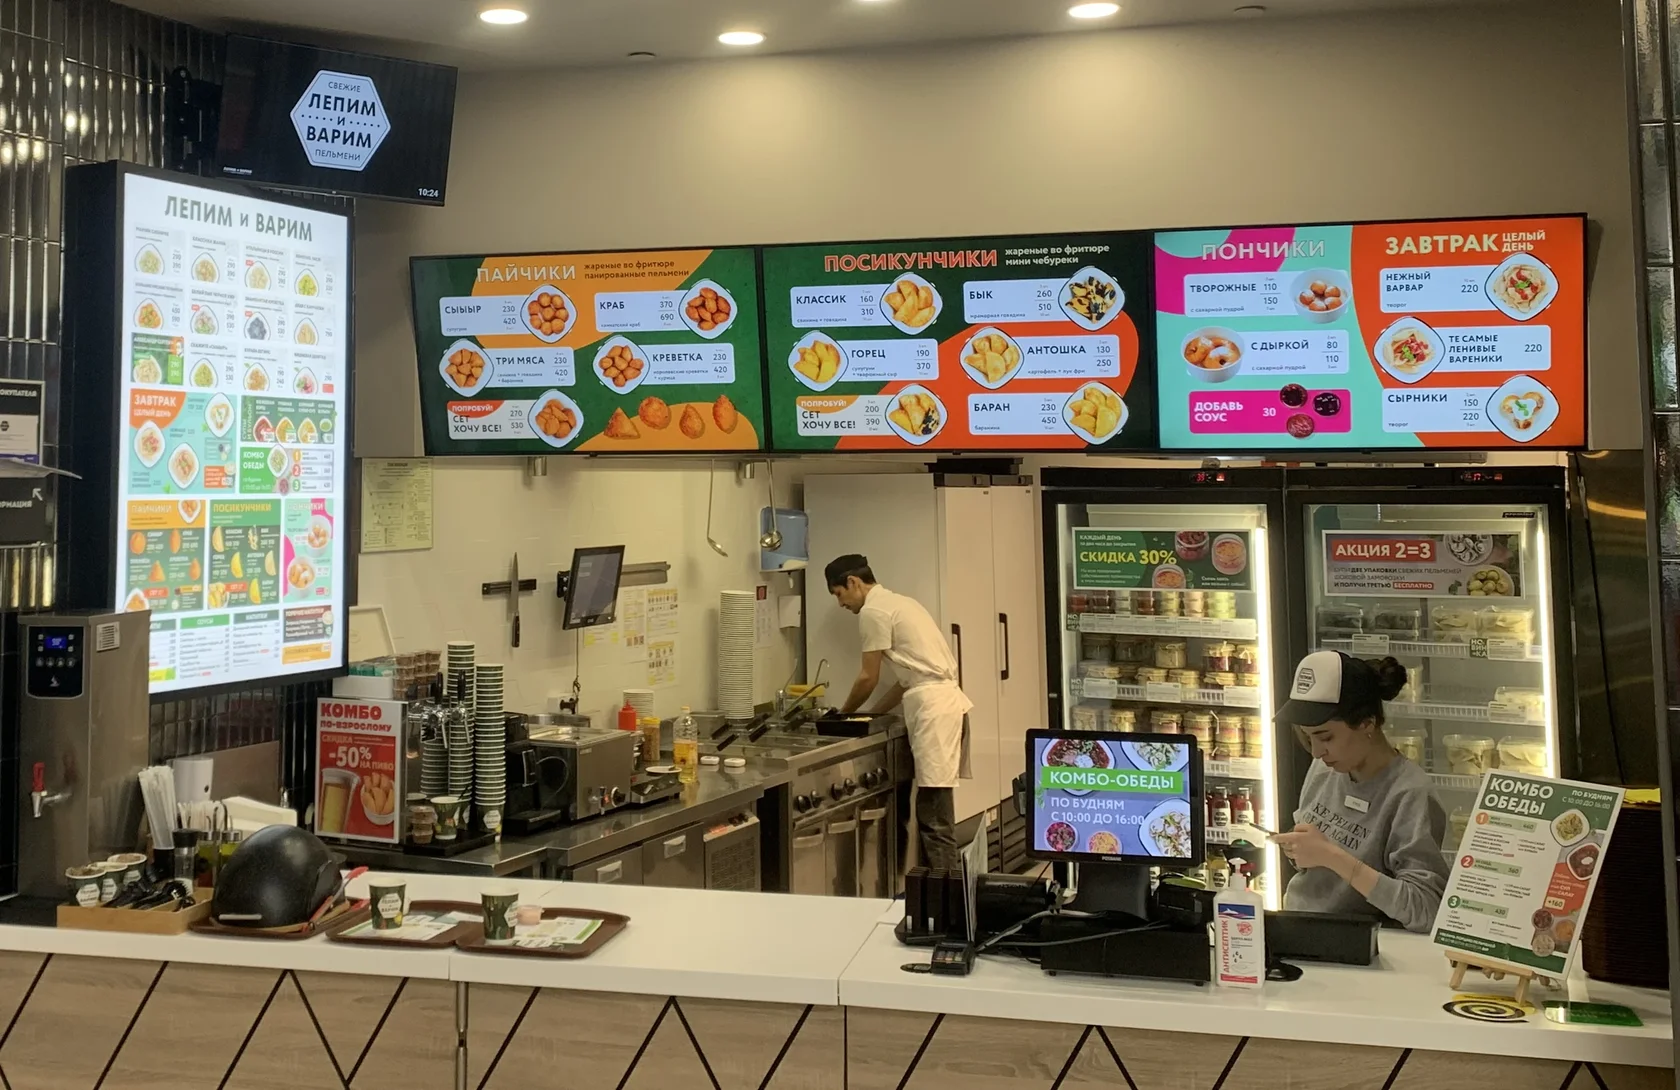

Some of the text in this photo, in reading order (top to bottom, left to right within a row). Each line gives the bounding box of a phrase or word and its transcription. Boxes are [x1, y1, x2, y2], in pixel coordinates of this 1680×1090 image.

[328, 81, 361, 93] СВЕЖИЕ
[308, 93, 376, 117] ЛЕПИМ
[337, 116, 346, 127] И
[306, 125, 372, 149] ВАРИМ
[315, 148, 361, 161] ПЕЛЬМЕНИ
[418, 188, 439, 198] 10:24
[164, 195, 233, 228] ЛЕПИМ
[255, 212, 313, 242] ВАРИМ
[1502, 230, 1546, 242] ЦЕЛЫЙ
[1385, 233, 1500, 255] ЗАВТРАК
[1501, 242, 1534, 253] ДЕНЬ
[1005, 247, 1048, 257] жареные
[1063, 244, 1110, 255] фритюре
[1202, 240, 1325, 261] ПОНЧИКИ
[824, 249, 998, 272] ПОСИКУНЧИКИ
[1005, 256, 1079, 266] мини чебуреки
[584, 262, 622, 271] жареные
[635, 260, 675, 270] фритюре
[476, 263, 577, 283] ПАЙЧИКИ
[584, 269, 690, 280] панированные пельмени
[1386, 271, 1431, 281] НЕЖНЫЙ
[1189, 283, 1257, 293] ТВОРОЖНЫЕ
[1263, 283, 1277, 291] 110
[1386, 283, 1424, 292] ВАРВАР
[1461, 284, 1479, 293] 220
[969, 290, 993, 300] БЫК
[1036, 290, 1052, 298] 260
[796, 295, 847, 304] КЛАССИК
[860, 295, 874, 303] 160
[1263, 297, 1278, 305] 150
[444, 305, 482, 314] СЫЫЫР
[502, 305, 516, 313] 230
[599, 301, 625, 310] КРАБ
[1038, 303, 1052, 311] 510
[861, 308, 874, 316] 310
[503, 317, 517, 325] 420
[660, 313, 675, 321] 690
[1448, 334, 1499, 343] ТЕ САМЫЕ
[1096, 345, 1111, 354] 130
[1250, 339, 1309, 351] С ДЫРКОЙ
[1326, 341, 1338, 349] 80
[1448, 344, 1497, 353] ЛЕНИВЫЕ
[1524, 344, 1543, 353] 220
[851, 349, 886, 359] ГОРЕЦ
[916, 349, 930, 357] 190
[1027, 345, 1087, 355] АНТОШКА
[495, 356, 545, 365] ТРИ МЯСА
[652, 353, 703, 362] КРЕВЕТКА
[713, 353, 727, 361] 230
[1325, 355, 1339, 363] 110
[1449, 355, 1503, 363] ВАРЕНИКИ
[916, 362, 931, 370] 370
[1096, 359, 1112, 367] 250
[554, 369, 568, 377] 420
[134, 394, 177, 407] ЗАВТРАК
[1387, 393, 1448, 403] СЫРНИКИ
[1463, 398, 1479, 407] 150
[801, 399, 847, 407] ПОПРОБУЙ!
[973, 403, 1010, 412] БАРАН
[1041, 403, 1056, 411] 230
[1194, 401, 1244, 412] ДОБАВЬ
[865, 405, 879, 413] 200
[1262, 407, 1277, 417] 30
[452, 415, 470, 423] СЕТ
[801, 410, 821, 419] СЕТ
[1194, 413, 1228, 422] СОУС
[1462, 412, 1480, 421] 220
[802, 420, 856, 429] ХОЧУ ВСЕ!
[865, 418, 880, 426] 390
[1041, 416, 1057, 424] 450
[453, 424, 502, 433] ХОЧУ ВСЕ!
[0, 500, 33, 508] РМАЦИЯ
[1335, 542, 1431, 559] АКЦИЯ 2=3
[1080, 549, 1177, 565] СКИДКА 30%
[320, 702, 382, 721] КОМБО
[320, 720, 392, 732] ПО-ВЗРОСЛОМУ
[321, 734, 353, 744] СКИДКА
[329, 745, 372, 768] -50%
[359, 760, 394, 771] НА ПИВО
[1050, 771, 1174, 790] КОМБО-ОБЕДЫ
[1489, 777, 1554, 799] КОМБО
[1571, 789, 1613, 801] ПО БУДНЯМ
[1051, 797, 1125, 811] ПО БУДНЯМ
[1484, 793, 1546, 816] ОБЕДЫ
[1567, 797, 1583, 805] 10:00
[1583, 798, 1594, 807] ДО
[1594, 800, 1611, 809] 16:00
[1051, 811, 1144, 826] С 10:00 ДО 16:00
[1479, 814, 1485, 822] 1
[1331, 829, 1362, 851] AGAIN
[1464, 857, 1471, 866] 2
[1450, 896, 1457, 906] 3
[1547, 899, 1563, 908] +160
[1494, 908, 1506, 916] 430
[1221, 919, 1230, 973] АНТИСЕПТИК
